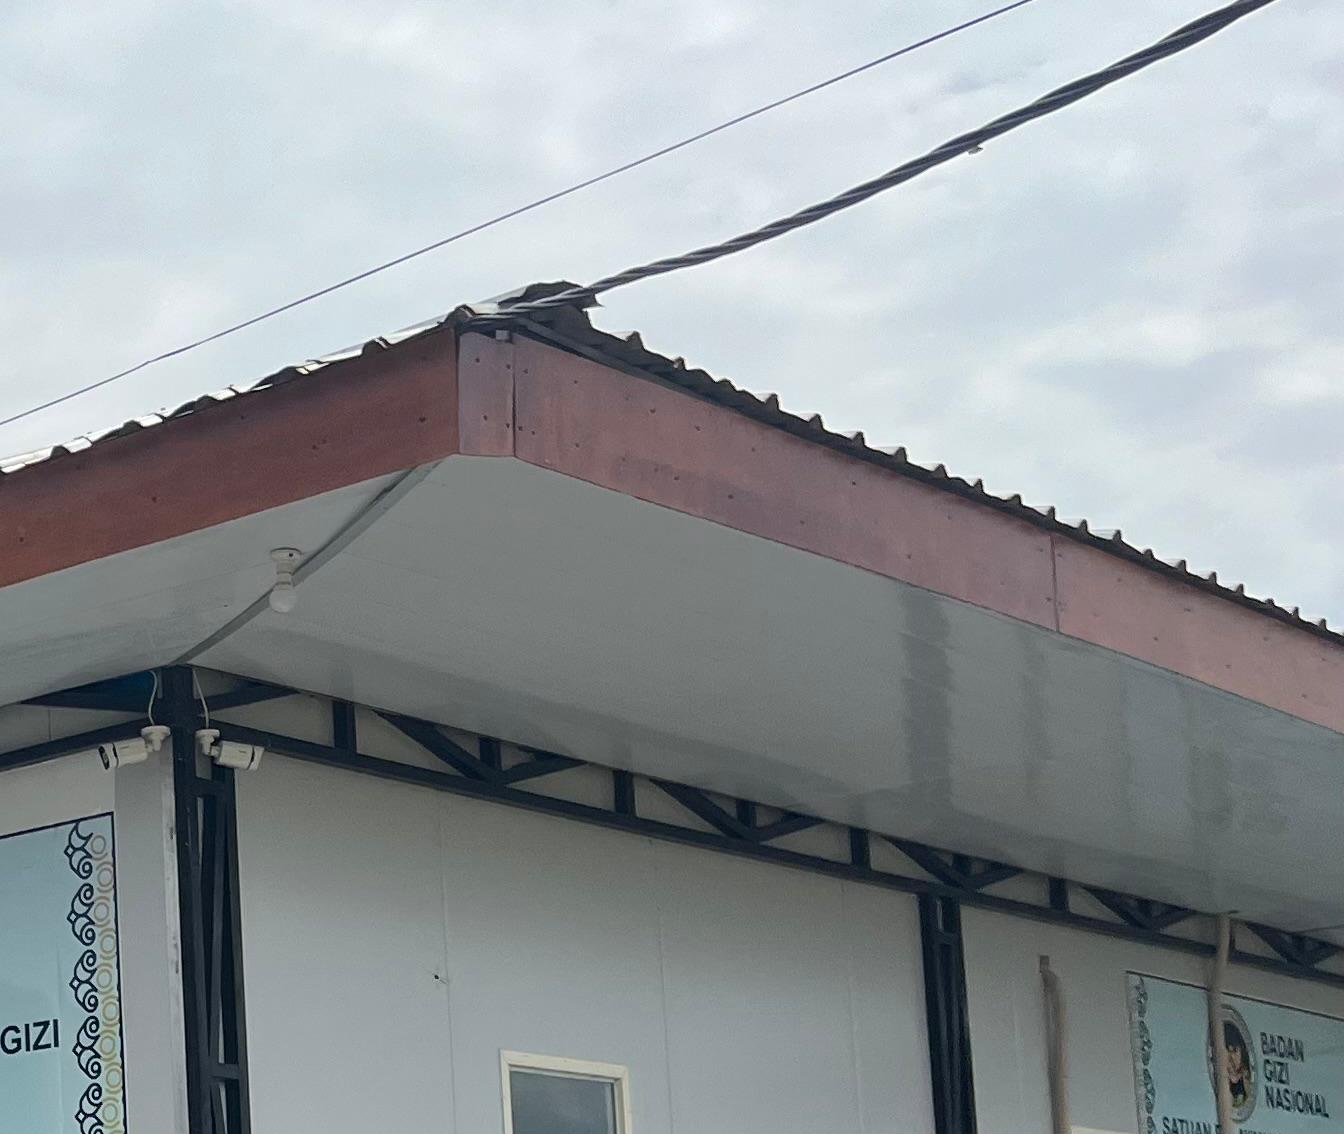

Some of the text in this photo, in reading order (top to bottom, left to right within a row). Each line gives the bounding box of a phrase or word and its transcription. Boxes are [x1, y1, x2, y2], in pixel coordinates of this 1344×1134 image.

[0, 1019, 60, 1055] GIZI
[1259, 1031, 1305, 1063] BADAN
[1263, 1059, 1290, 1086] GIZI
[1264, 1084, 1330, 1119] NASIONAL
